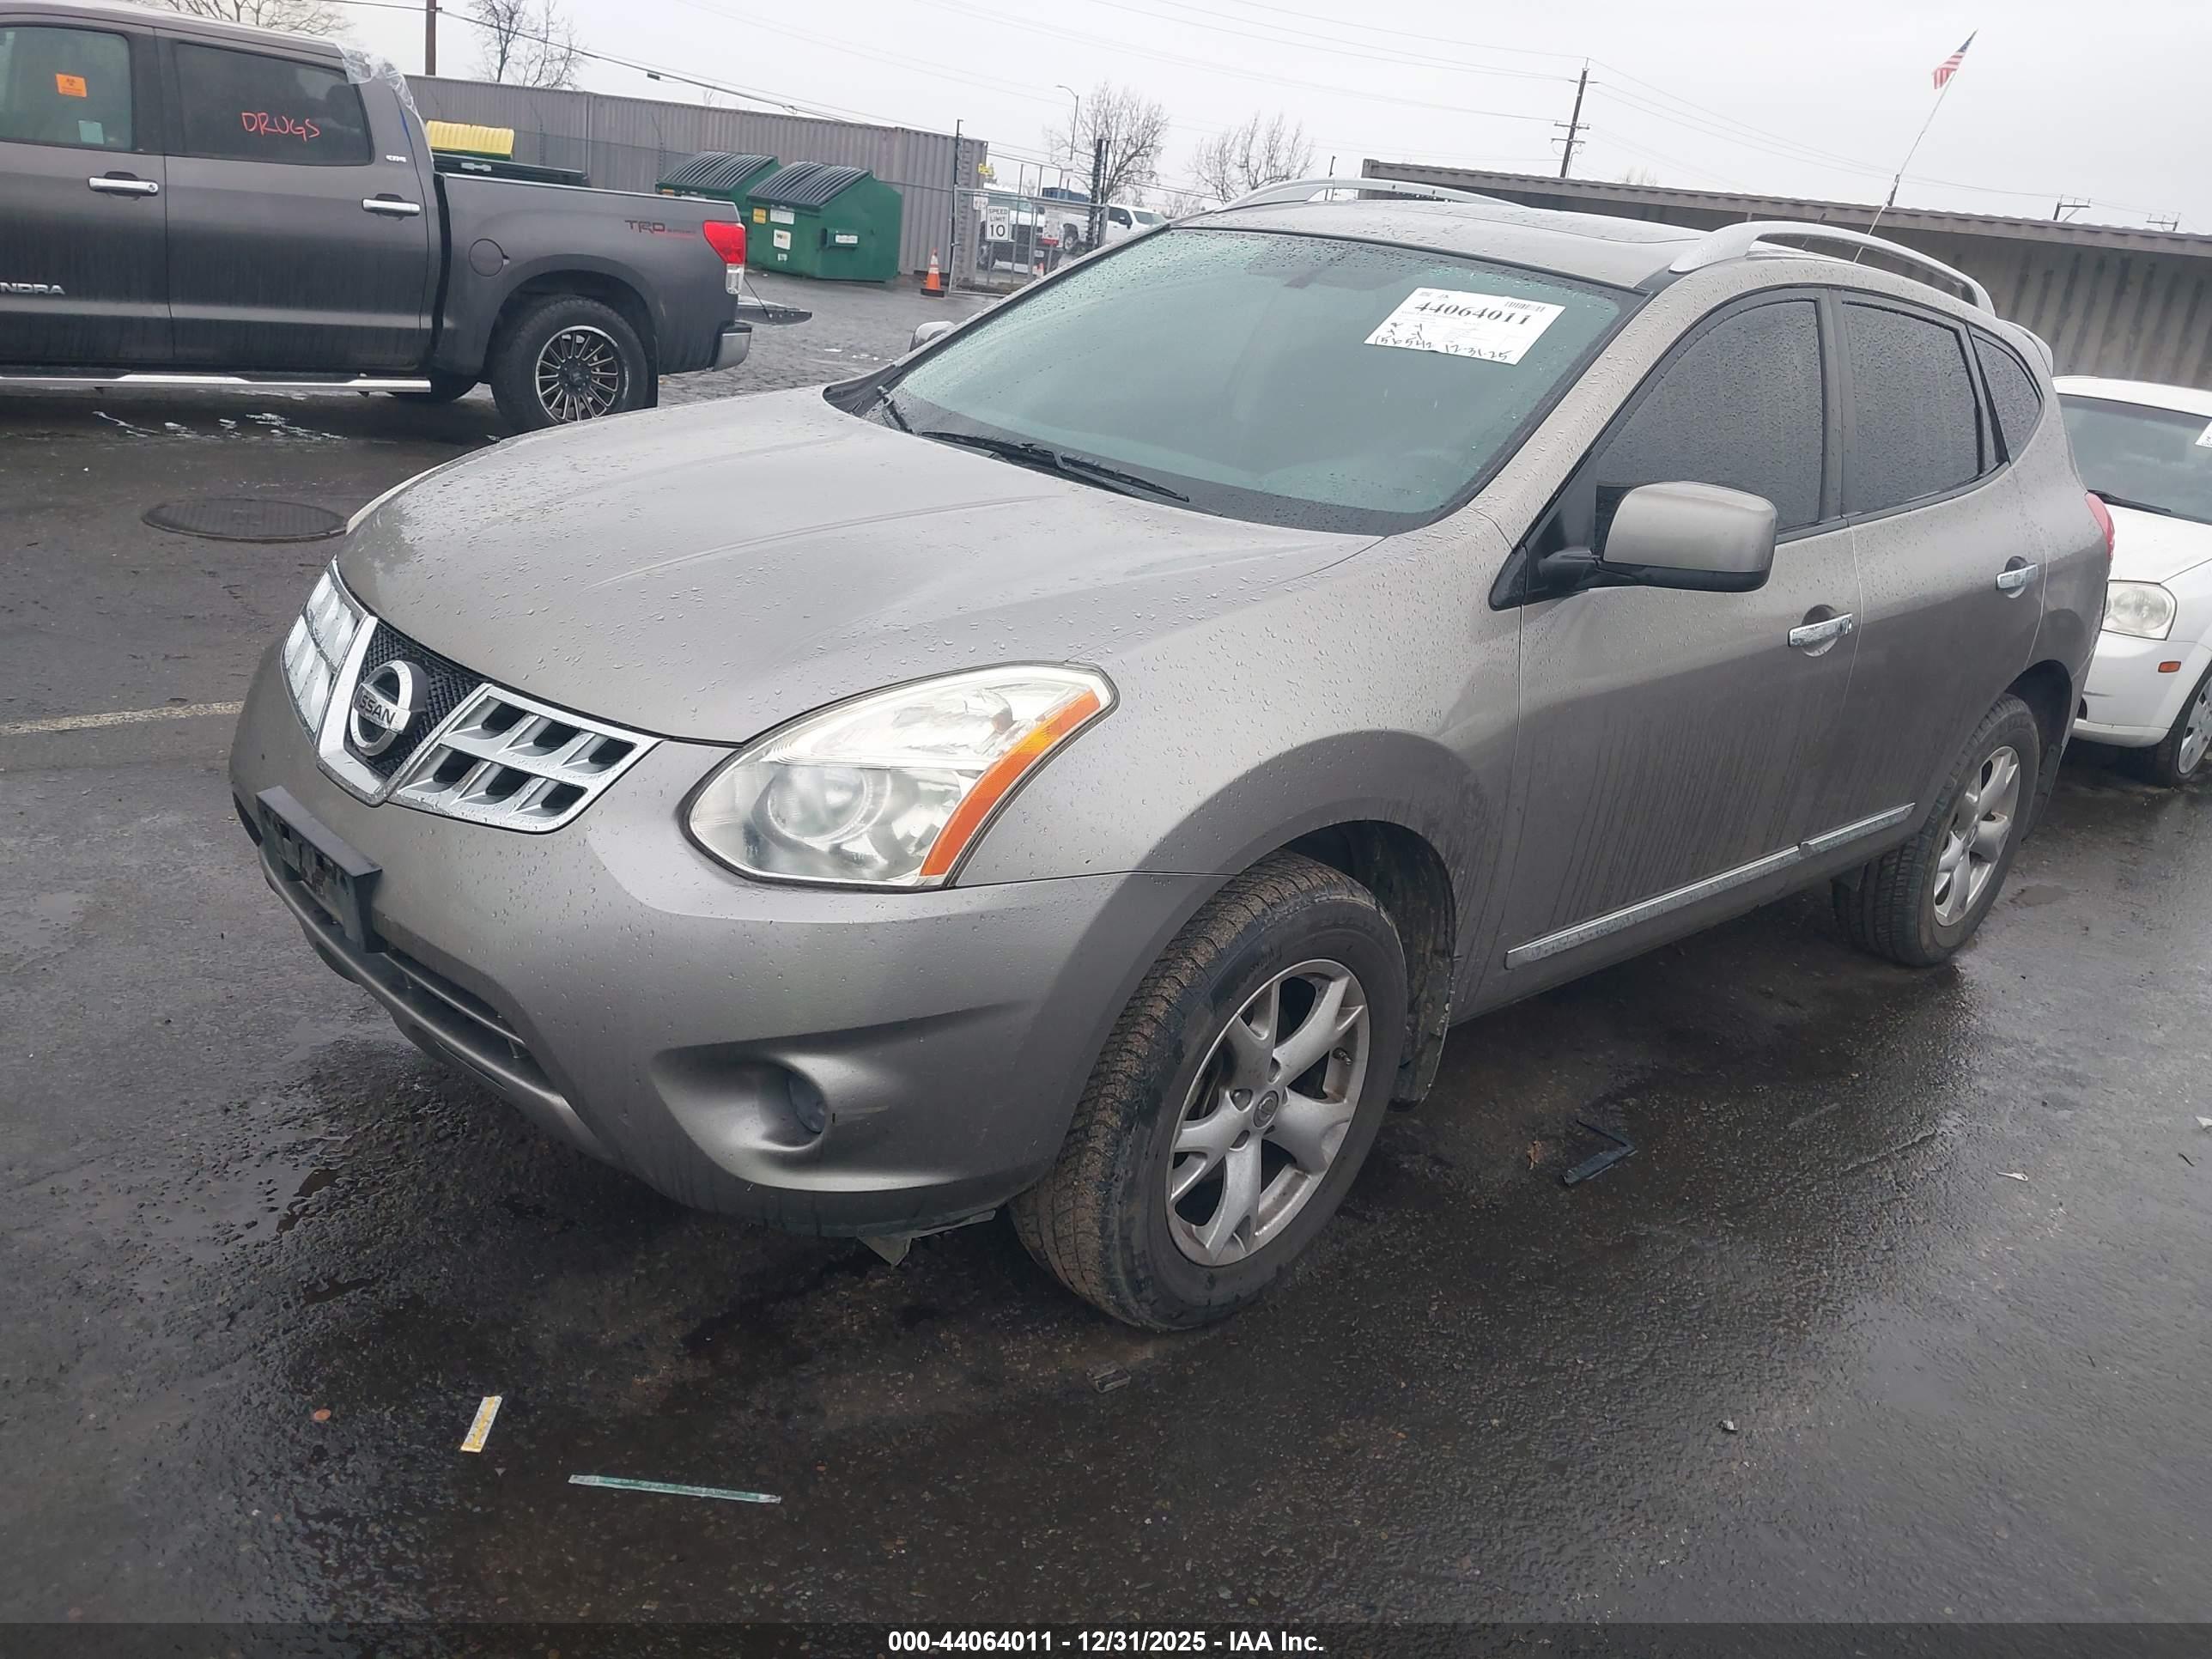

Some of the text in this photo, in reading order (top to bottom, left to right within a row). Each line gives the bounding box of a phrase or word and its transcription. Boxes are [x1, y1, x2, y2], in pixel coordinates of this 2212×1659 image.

[241, 112, 320, 142] DRUGS
[624, 219, 665, 234] TRD
[989, 224, 1006, 238] 10
[1414, 301, 1532, 325] 44064011
[356, 692, 397, 726] SSAN
